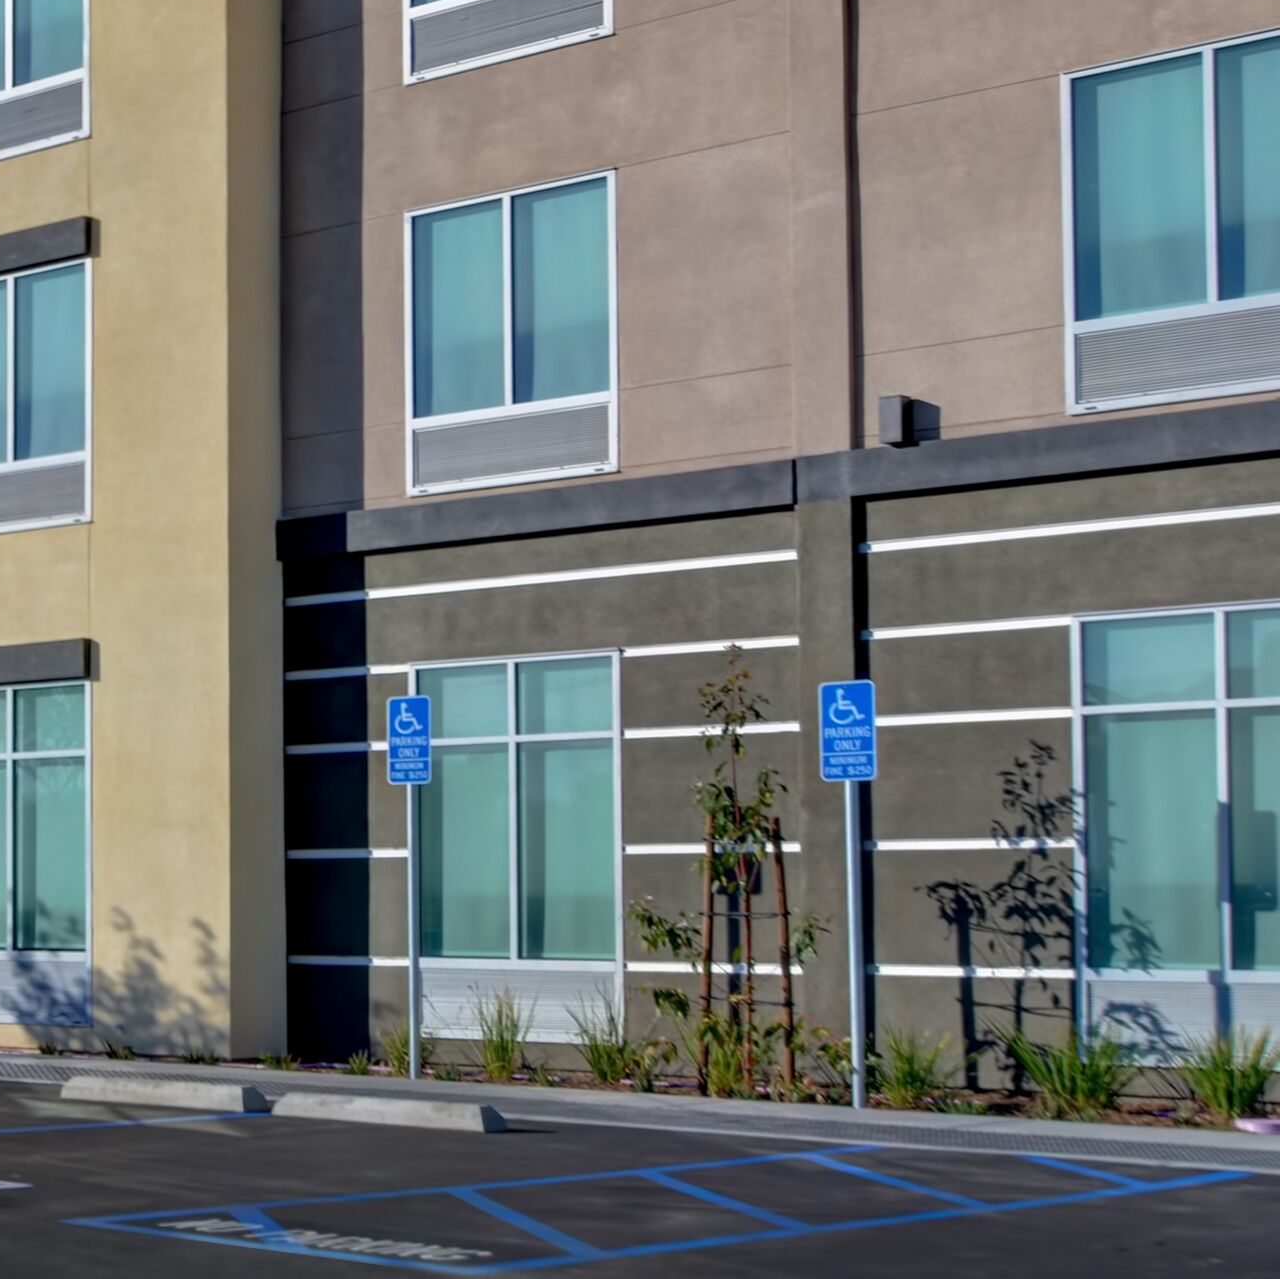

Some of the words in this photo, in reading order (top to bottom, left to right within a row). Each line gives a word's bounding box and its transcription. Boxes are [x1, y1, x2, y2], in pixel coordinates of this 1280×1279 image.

[824, 726, 871, 738] PARKING
[391, 736, 427, 747] PARKING
[834, 740, 861, 751] ONLY
[398, 748, 420, 758] ONLY
[829, 756, 867, 765] MINIMUM
